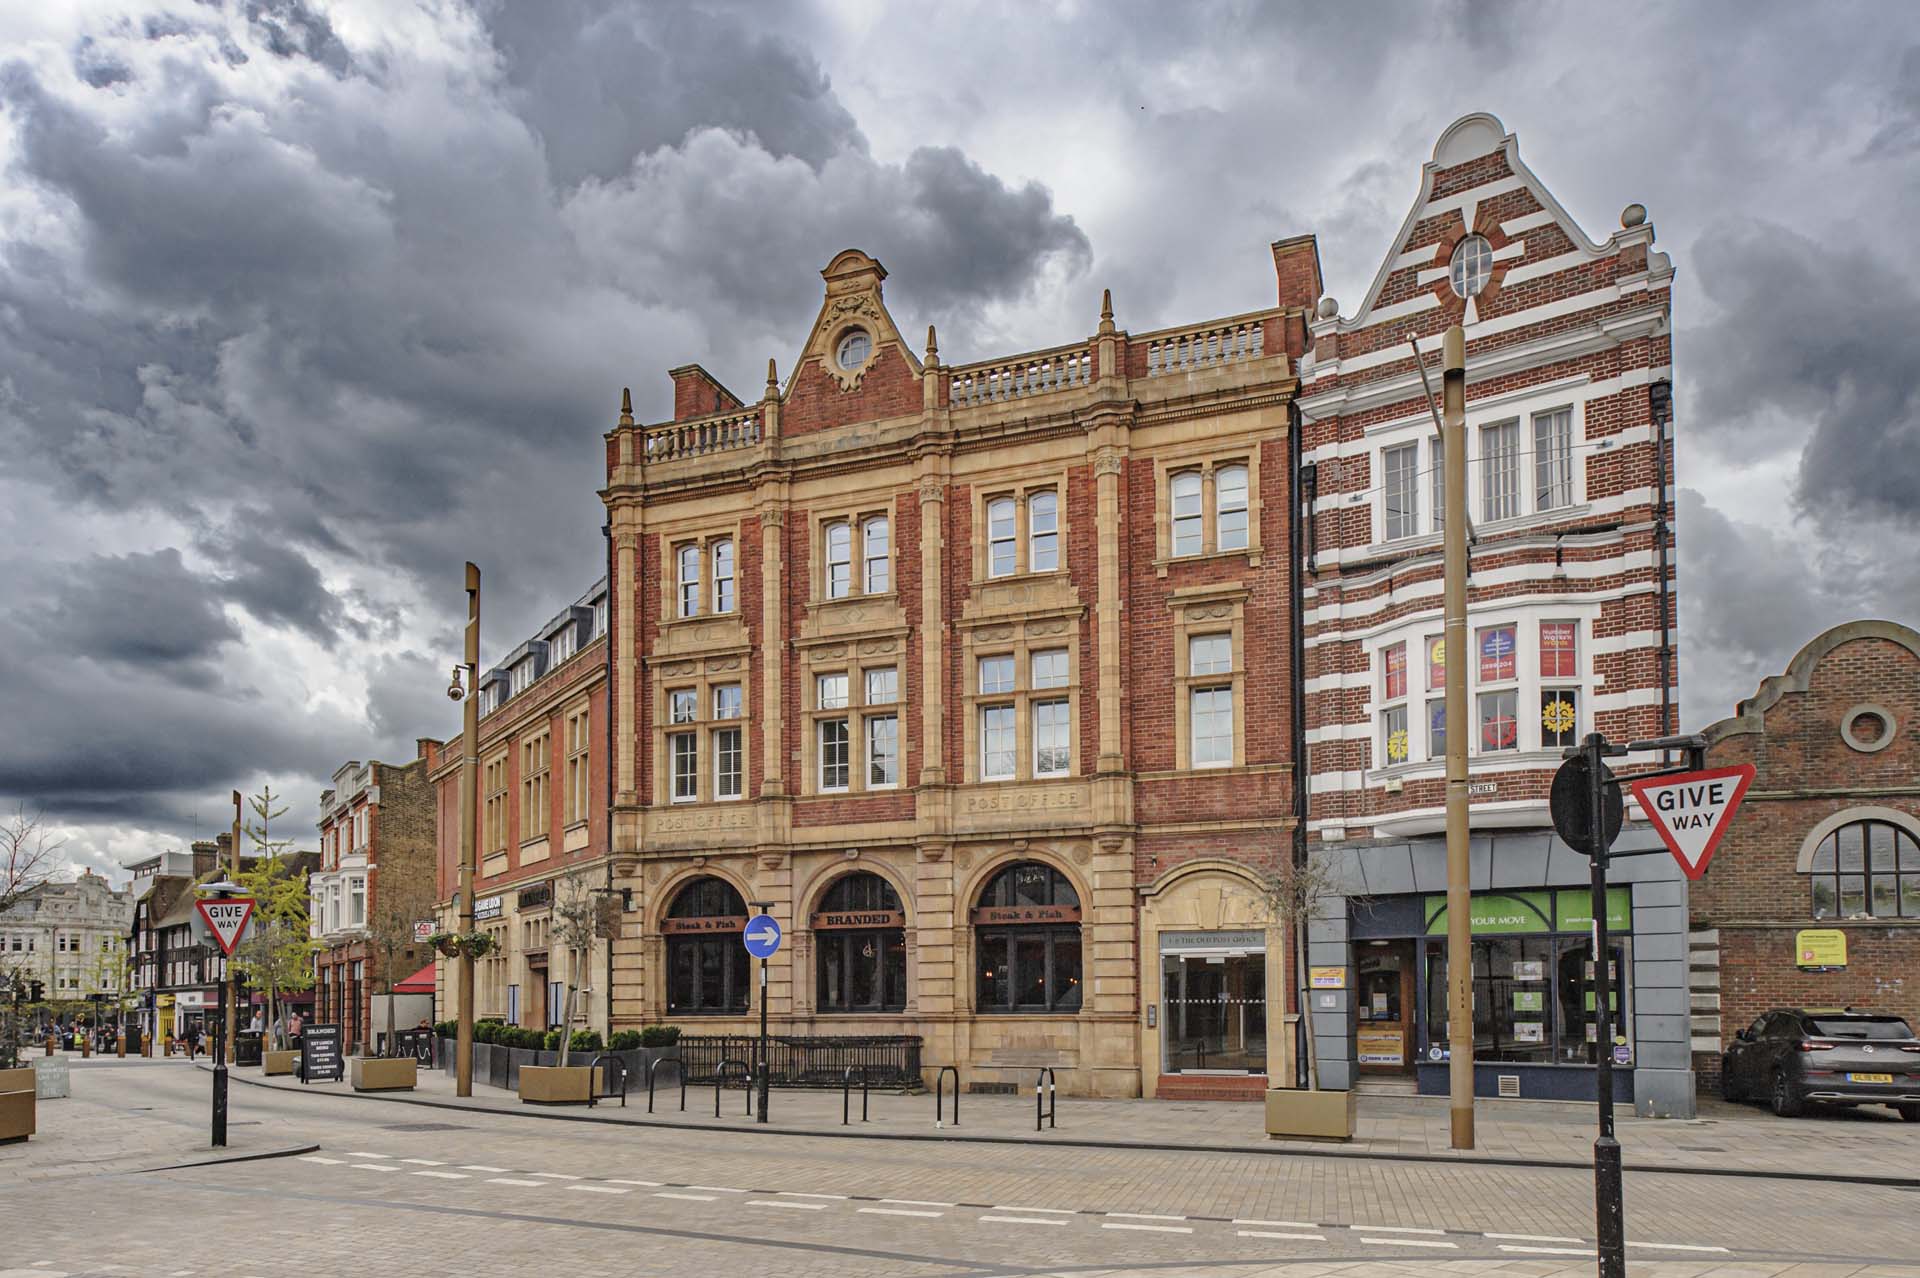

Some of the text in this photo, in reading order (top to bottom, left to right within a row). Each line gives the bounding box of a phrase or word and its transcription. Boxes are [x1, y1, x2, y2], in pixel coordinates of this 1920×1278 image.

[1470, 784, 1496, 793] STREET
[1656, 783, 1725, 811] GIVE
[967, 797, 1011, 811] POST
[1672, 812, 1714, 831] WAY
[209, 906, 243, 918] GIVE
[990, 909, 1064, 921] Steak & Fish
[218, 920, 238, 929] WAY
[705, 921, 713, 929] &
[716, 920, 737, 929] Fish
[826, 914, 891, 926] BRANDED
[1471, 915, 1527, 926] YOUR MOVE
[1181, 936, 1195, 944] THE
[1213, 935, 1231, 944] POST
[1232, 934, 1257, 943] OFFICE
